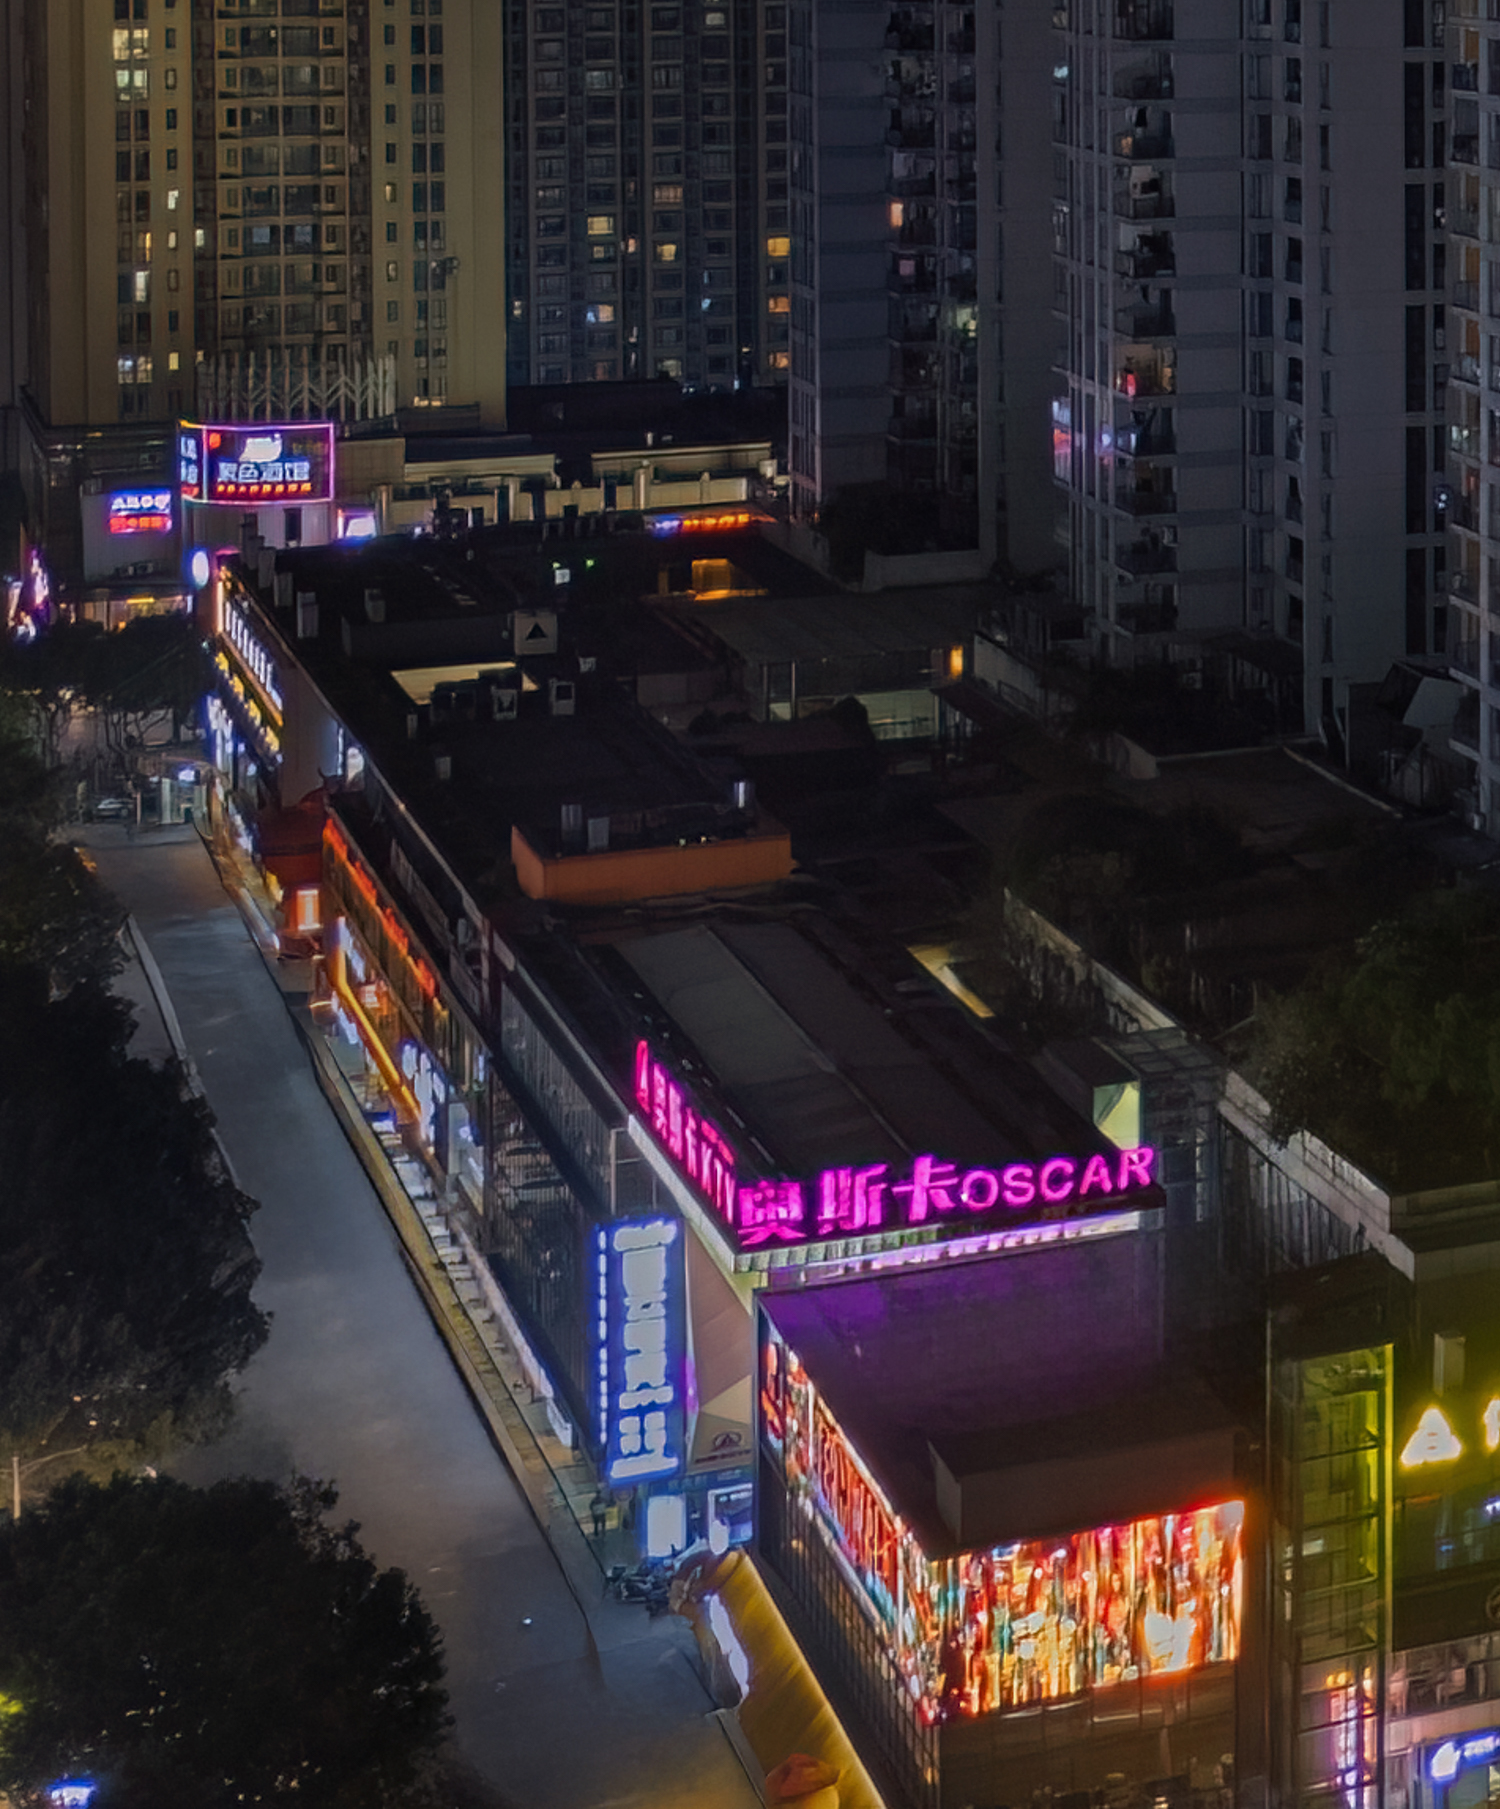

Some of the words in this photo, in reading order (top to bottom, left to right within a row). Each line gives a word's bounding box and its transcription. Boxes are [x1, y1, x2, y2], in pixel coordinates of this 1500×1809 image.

[737, 1154, 959, 1246] 奥斯卡
[961, 1146, 1157, 1207] OSCAR
